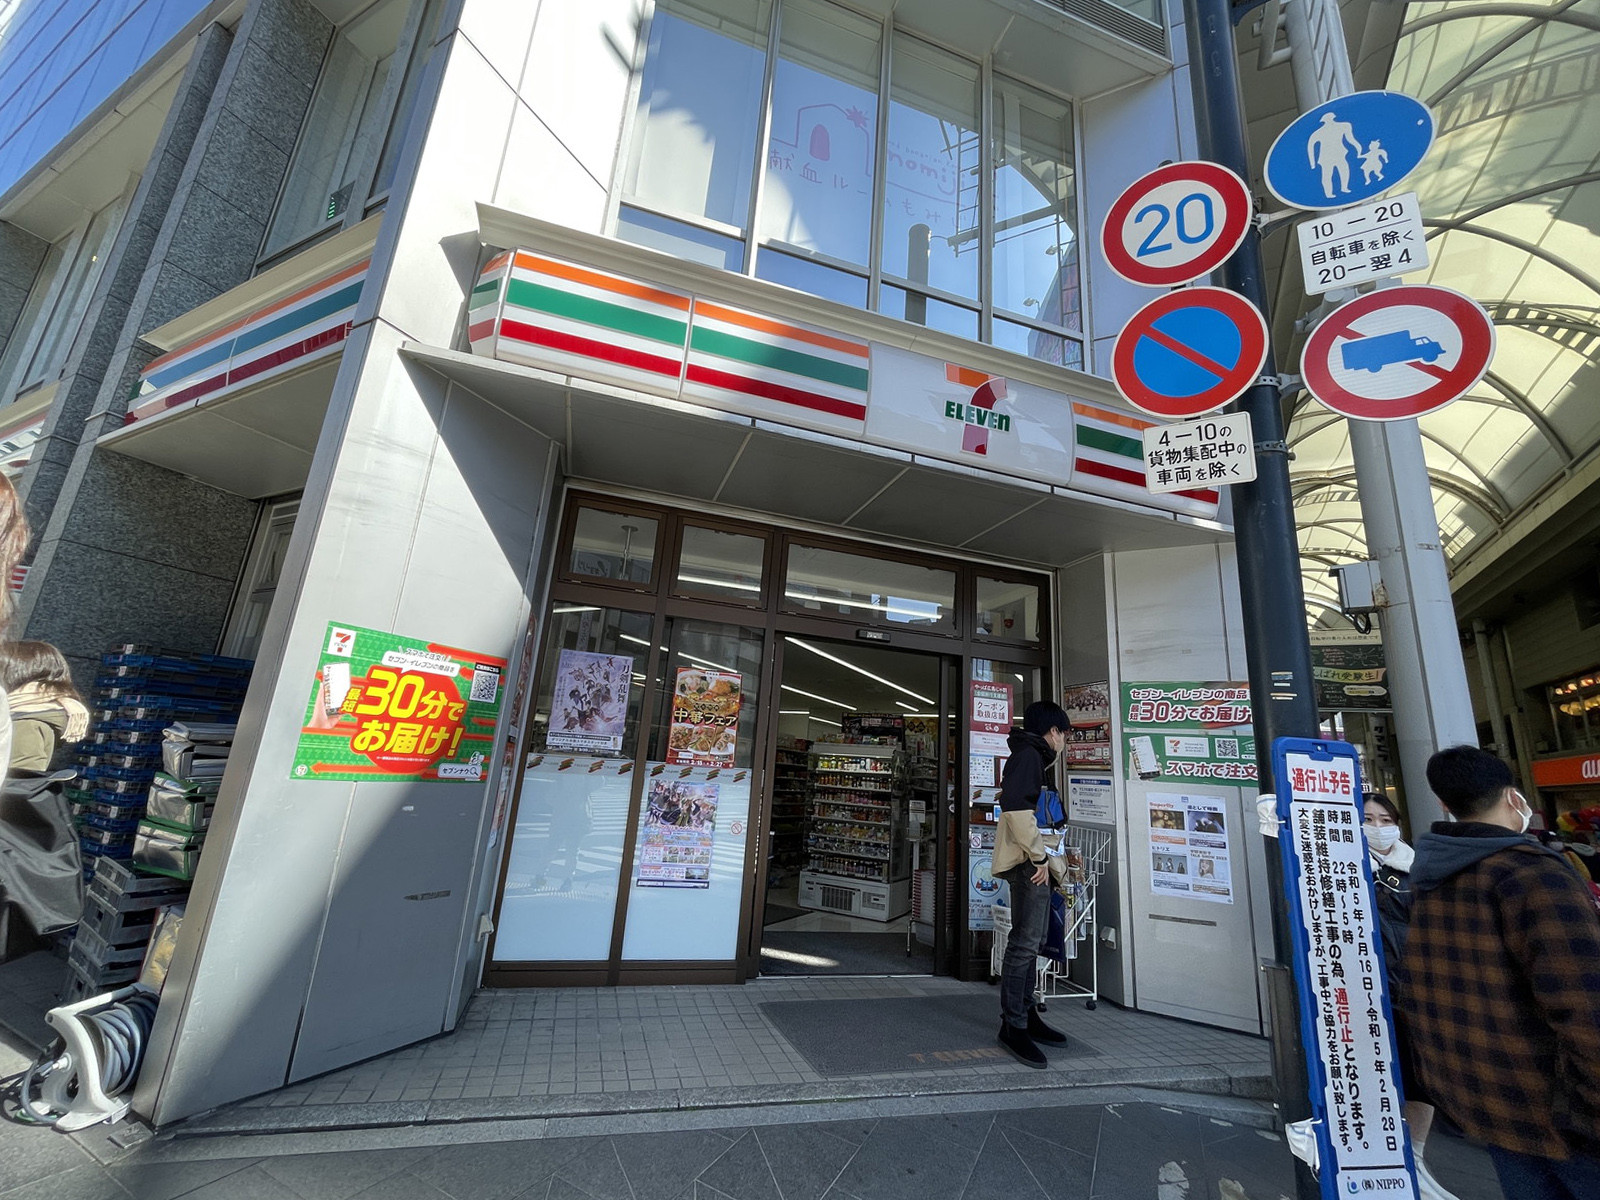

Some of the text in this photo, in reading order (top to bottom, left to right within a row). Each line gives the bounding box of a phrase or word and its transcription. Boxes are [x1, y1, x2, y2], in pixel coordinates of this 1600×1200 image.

[1134, 192, 1215, 258] 20
[1311, 230, 1414, 266] 自転車を除く
[1148, 440, 1247, 468] 貨物集配中の
[1157, 461, 1240, 485] 車両を除く
[674, 707, 738, 726] 中華フェア
[977, 701, 1005, 711] クーポン
[353, 719, 464, 757] お届け!
[1166, 761, 1258, 779] スマホで注文
[1292, 768, 1351, 795] 通行止予告
[1376, 1176, 1406, 1190] NIPPO
